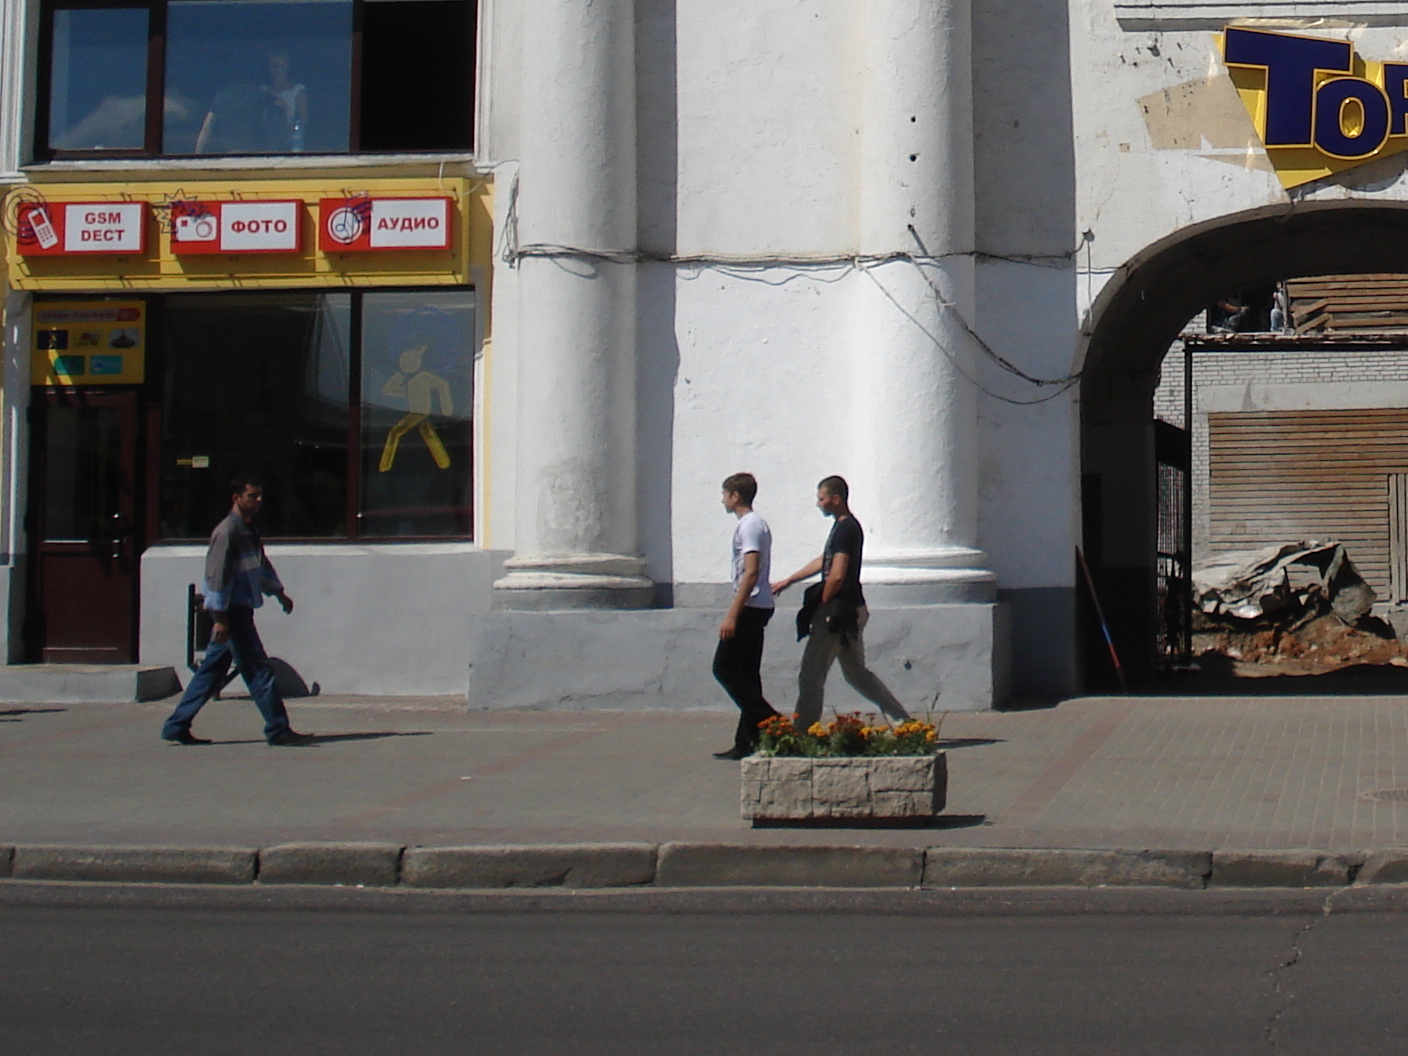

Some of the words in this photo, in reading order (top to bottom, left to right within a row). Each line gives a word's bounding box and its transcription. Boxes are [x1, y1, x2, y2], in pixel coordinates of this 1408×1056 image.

[84, 212, 121, 224] GSM
[377, 217, 439, 230] АУДИО
[231, 219, 287, 233] ФОТО
[81, 229, 125, 241] DECT
